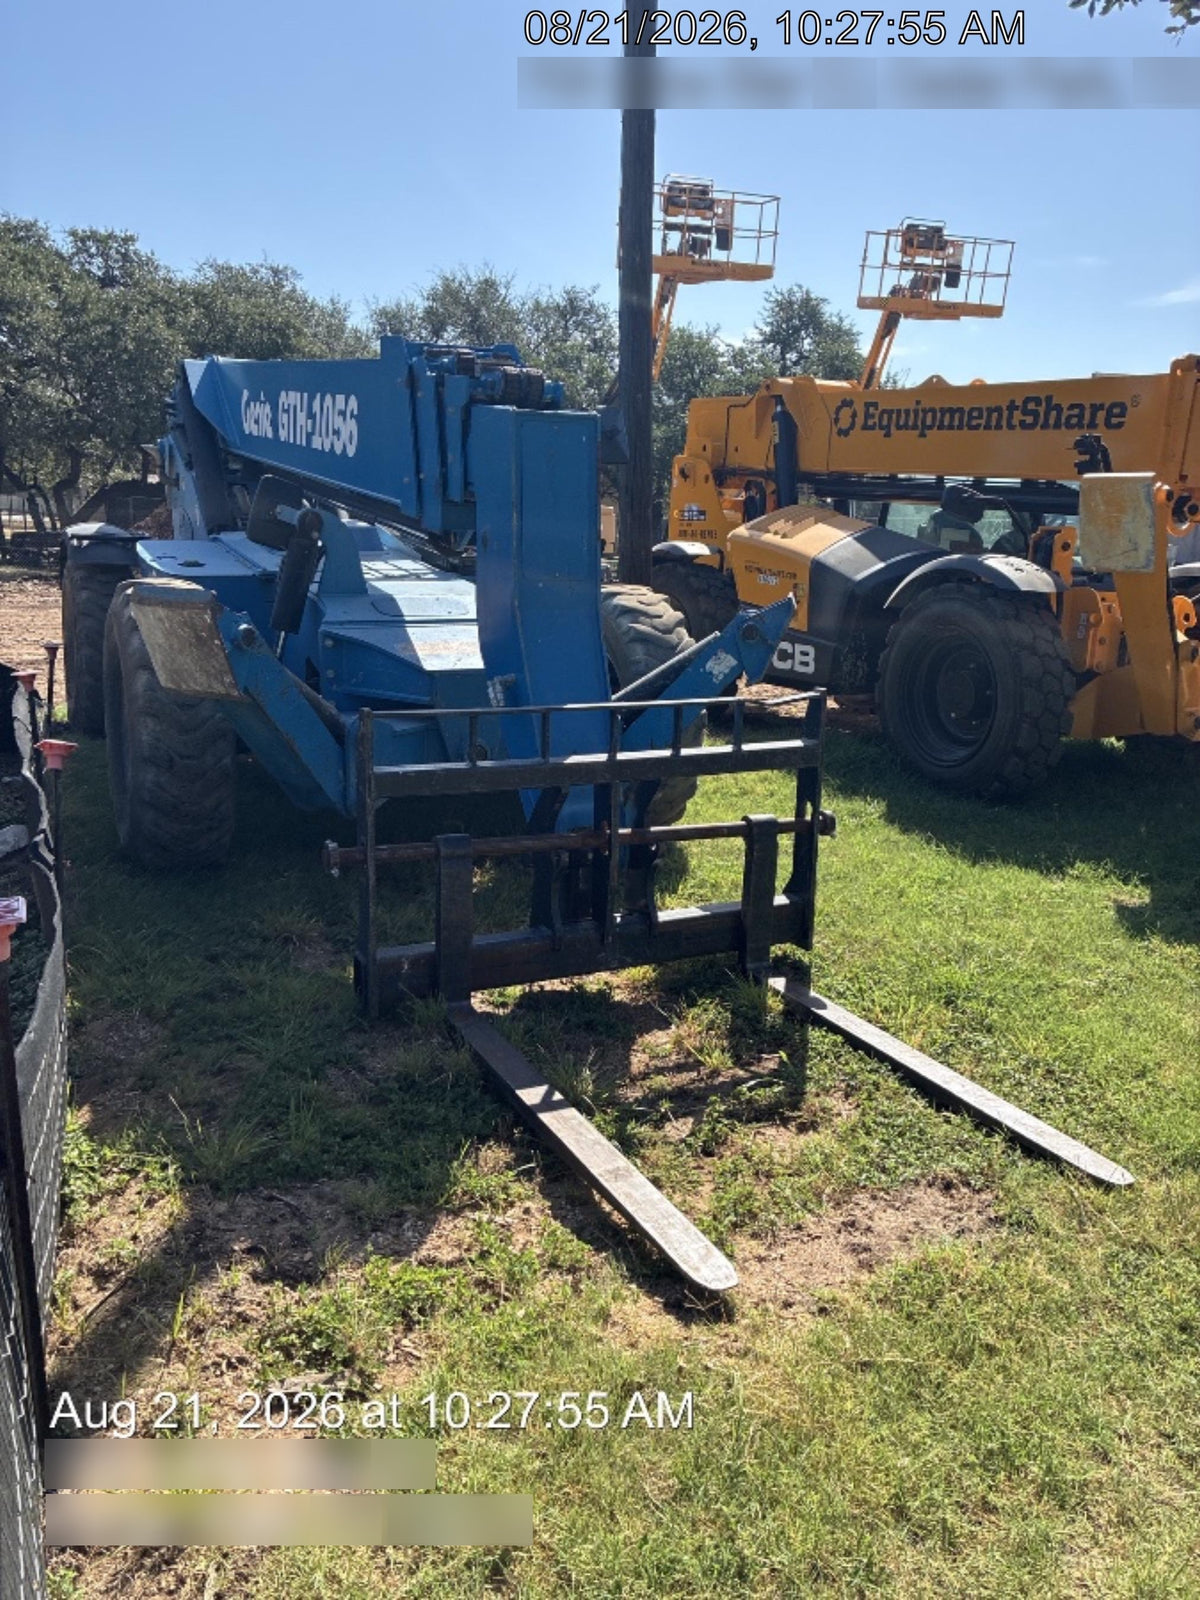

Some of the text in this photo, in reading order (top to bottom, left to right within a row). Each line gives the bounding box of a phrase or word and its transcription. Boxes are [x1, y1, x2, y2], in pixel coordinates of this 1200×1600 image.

[279, 390, 358, 458] GTH-1056
[861, 395, 1128, 438] EquipmentShare
[771, 641, 816, 675] CB
